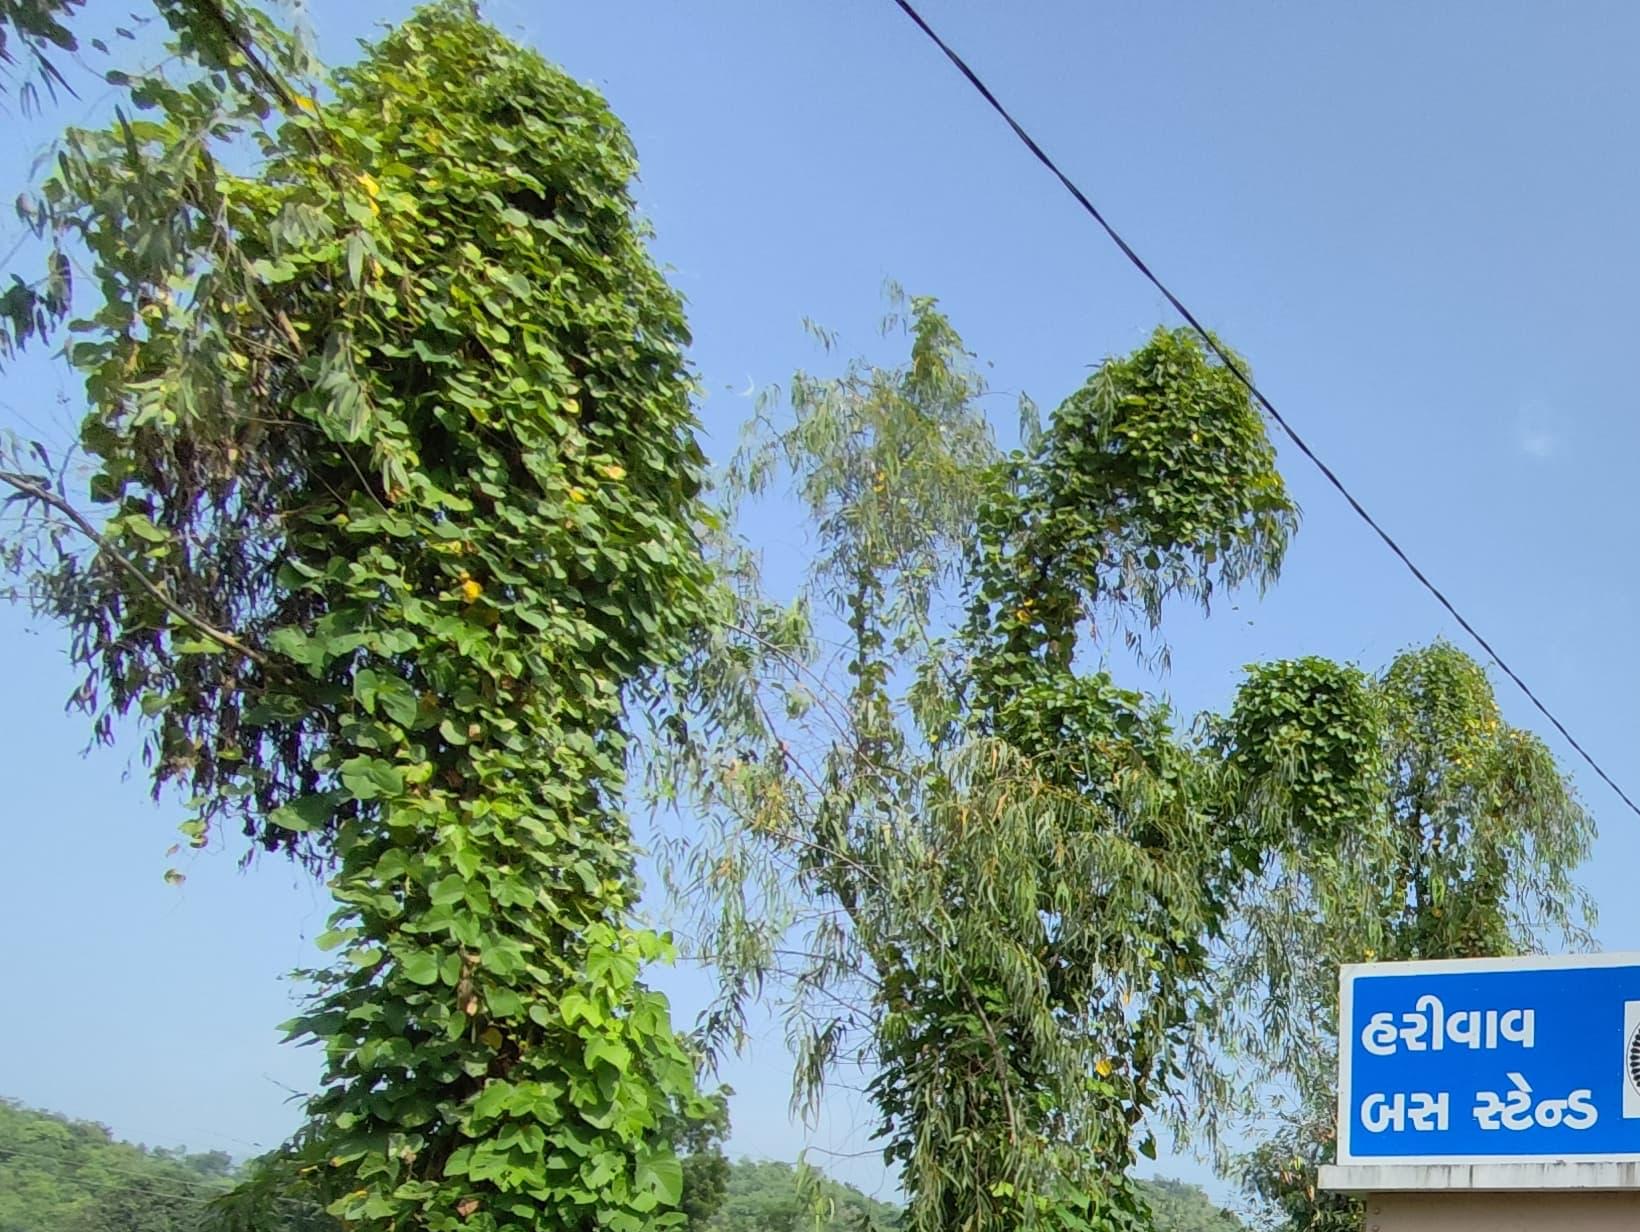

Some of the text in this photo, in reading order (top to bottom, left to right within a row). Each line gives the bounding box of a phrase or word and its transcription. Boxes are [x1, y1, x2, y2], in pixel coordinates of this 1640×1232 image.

[1361, 994, 1535, 1056] હરીવાવ
[1361, 1072, 1598, 1132] બસ સ્ટેન્ડ
